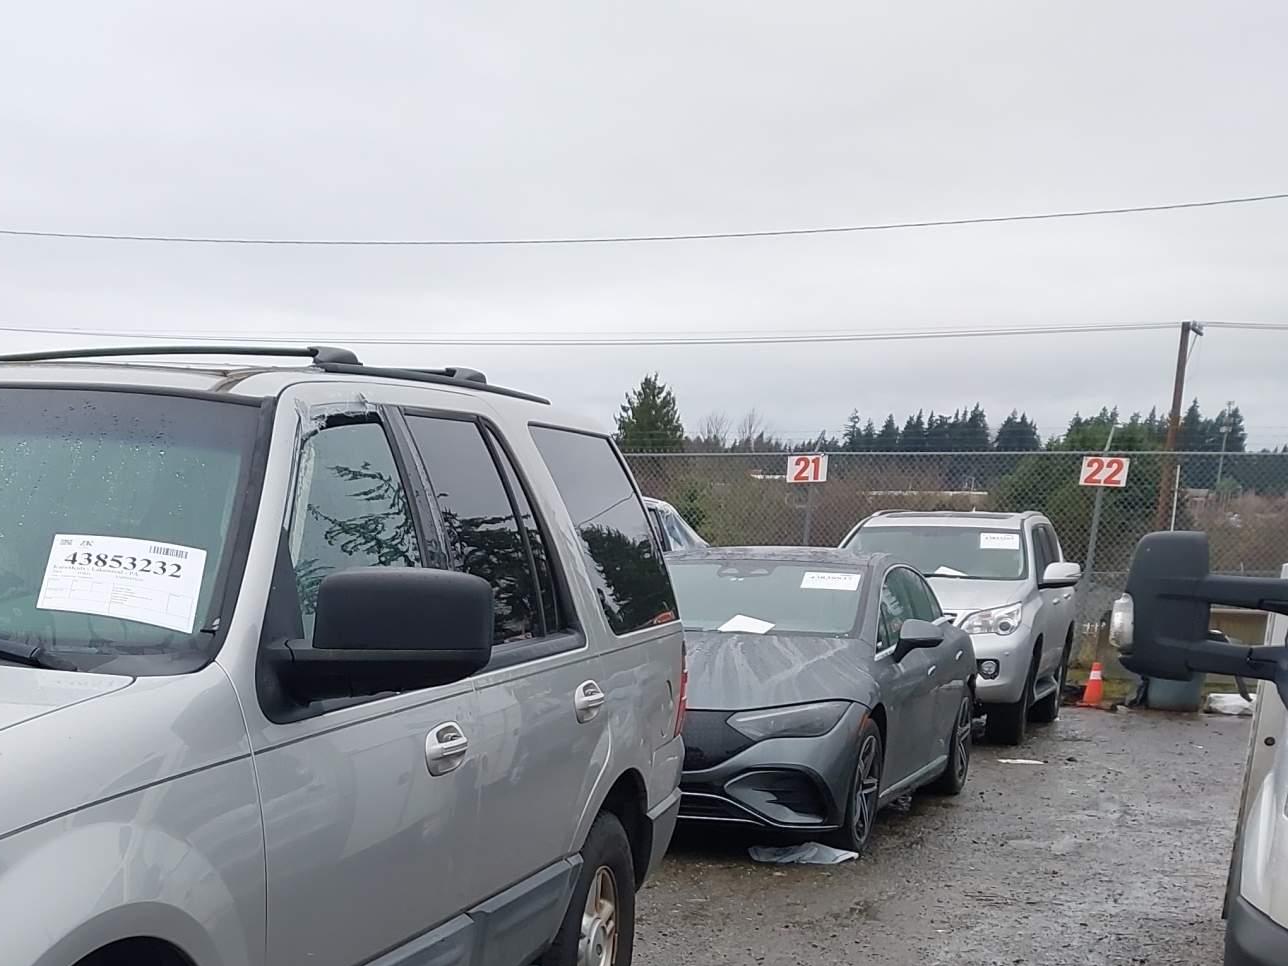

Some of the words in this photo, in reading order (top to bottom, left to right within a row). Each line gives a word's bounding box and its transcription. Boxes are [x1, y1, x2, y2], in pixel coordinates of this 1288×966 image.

[793, 457, 821, 481] 21
[1083, 458, 1125, 485] 22
[64, 551, 183, 578] 43853232
